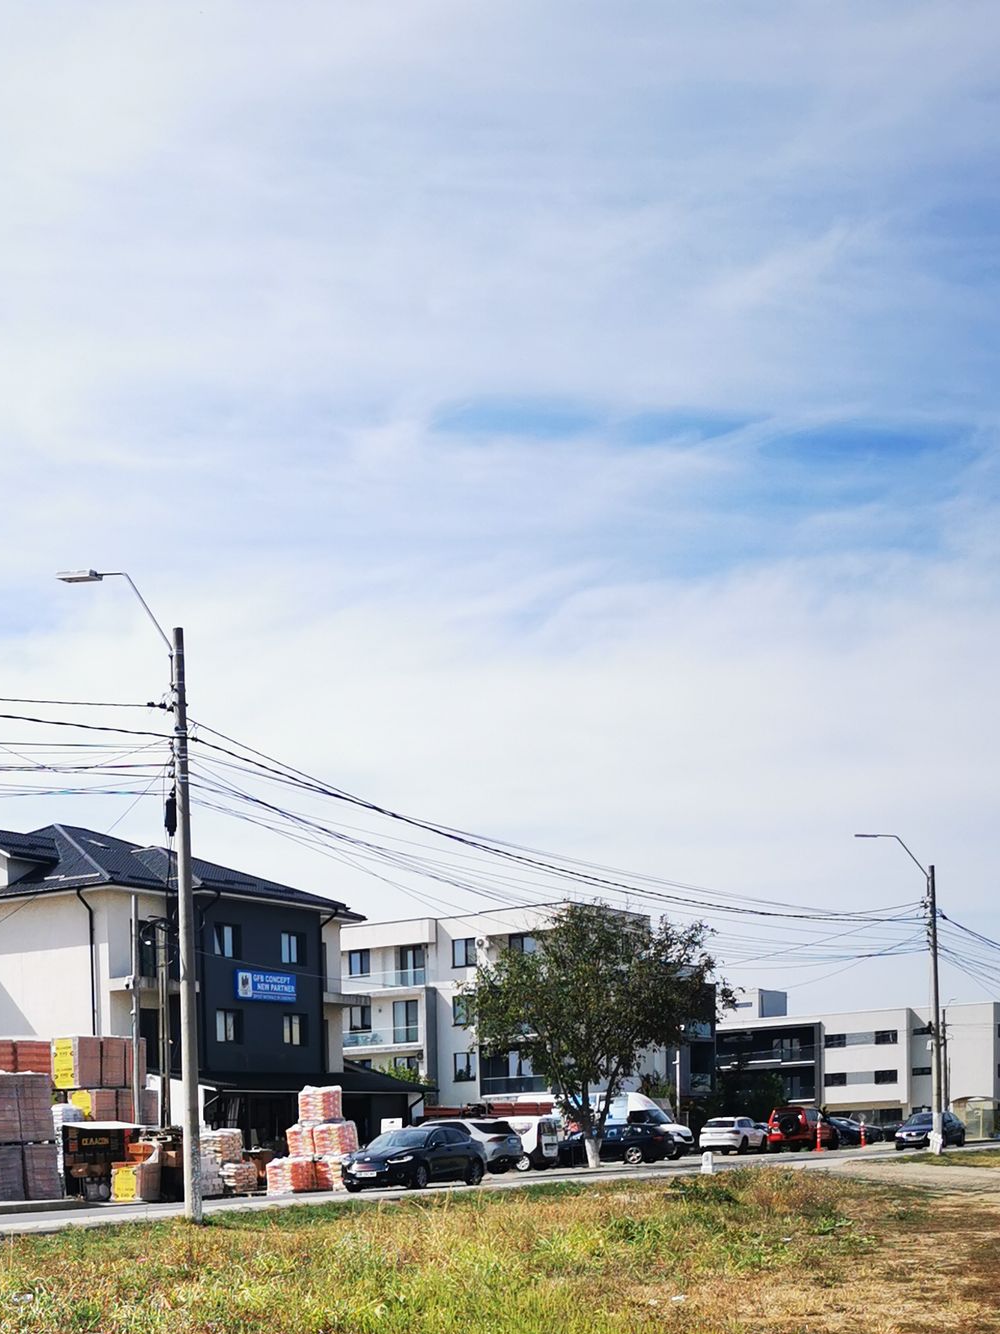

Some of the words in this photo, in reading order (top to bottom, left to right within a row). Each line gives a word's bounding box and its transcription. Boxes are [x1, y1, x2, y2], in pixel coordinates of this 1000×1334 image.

[265, 975, 291, 984] CONCEPT
[257, 983, 269, 991] NEW
[270, 984, 295, 992] PARTNER
